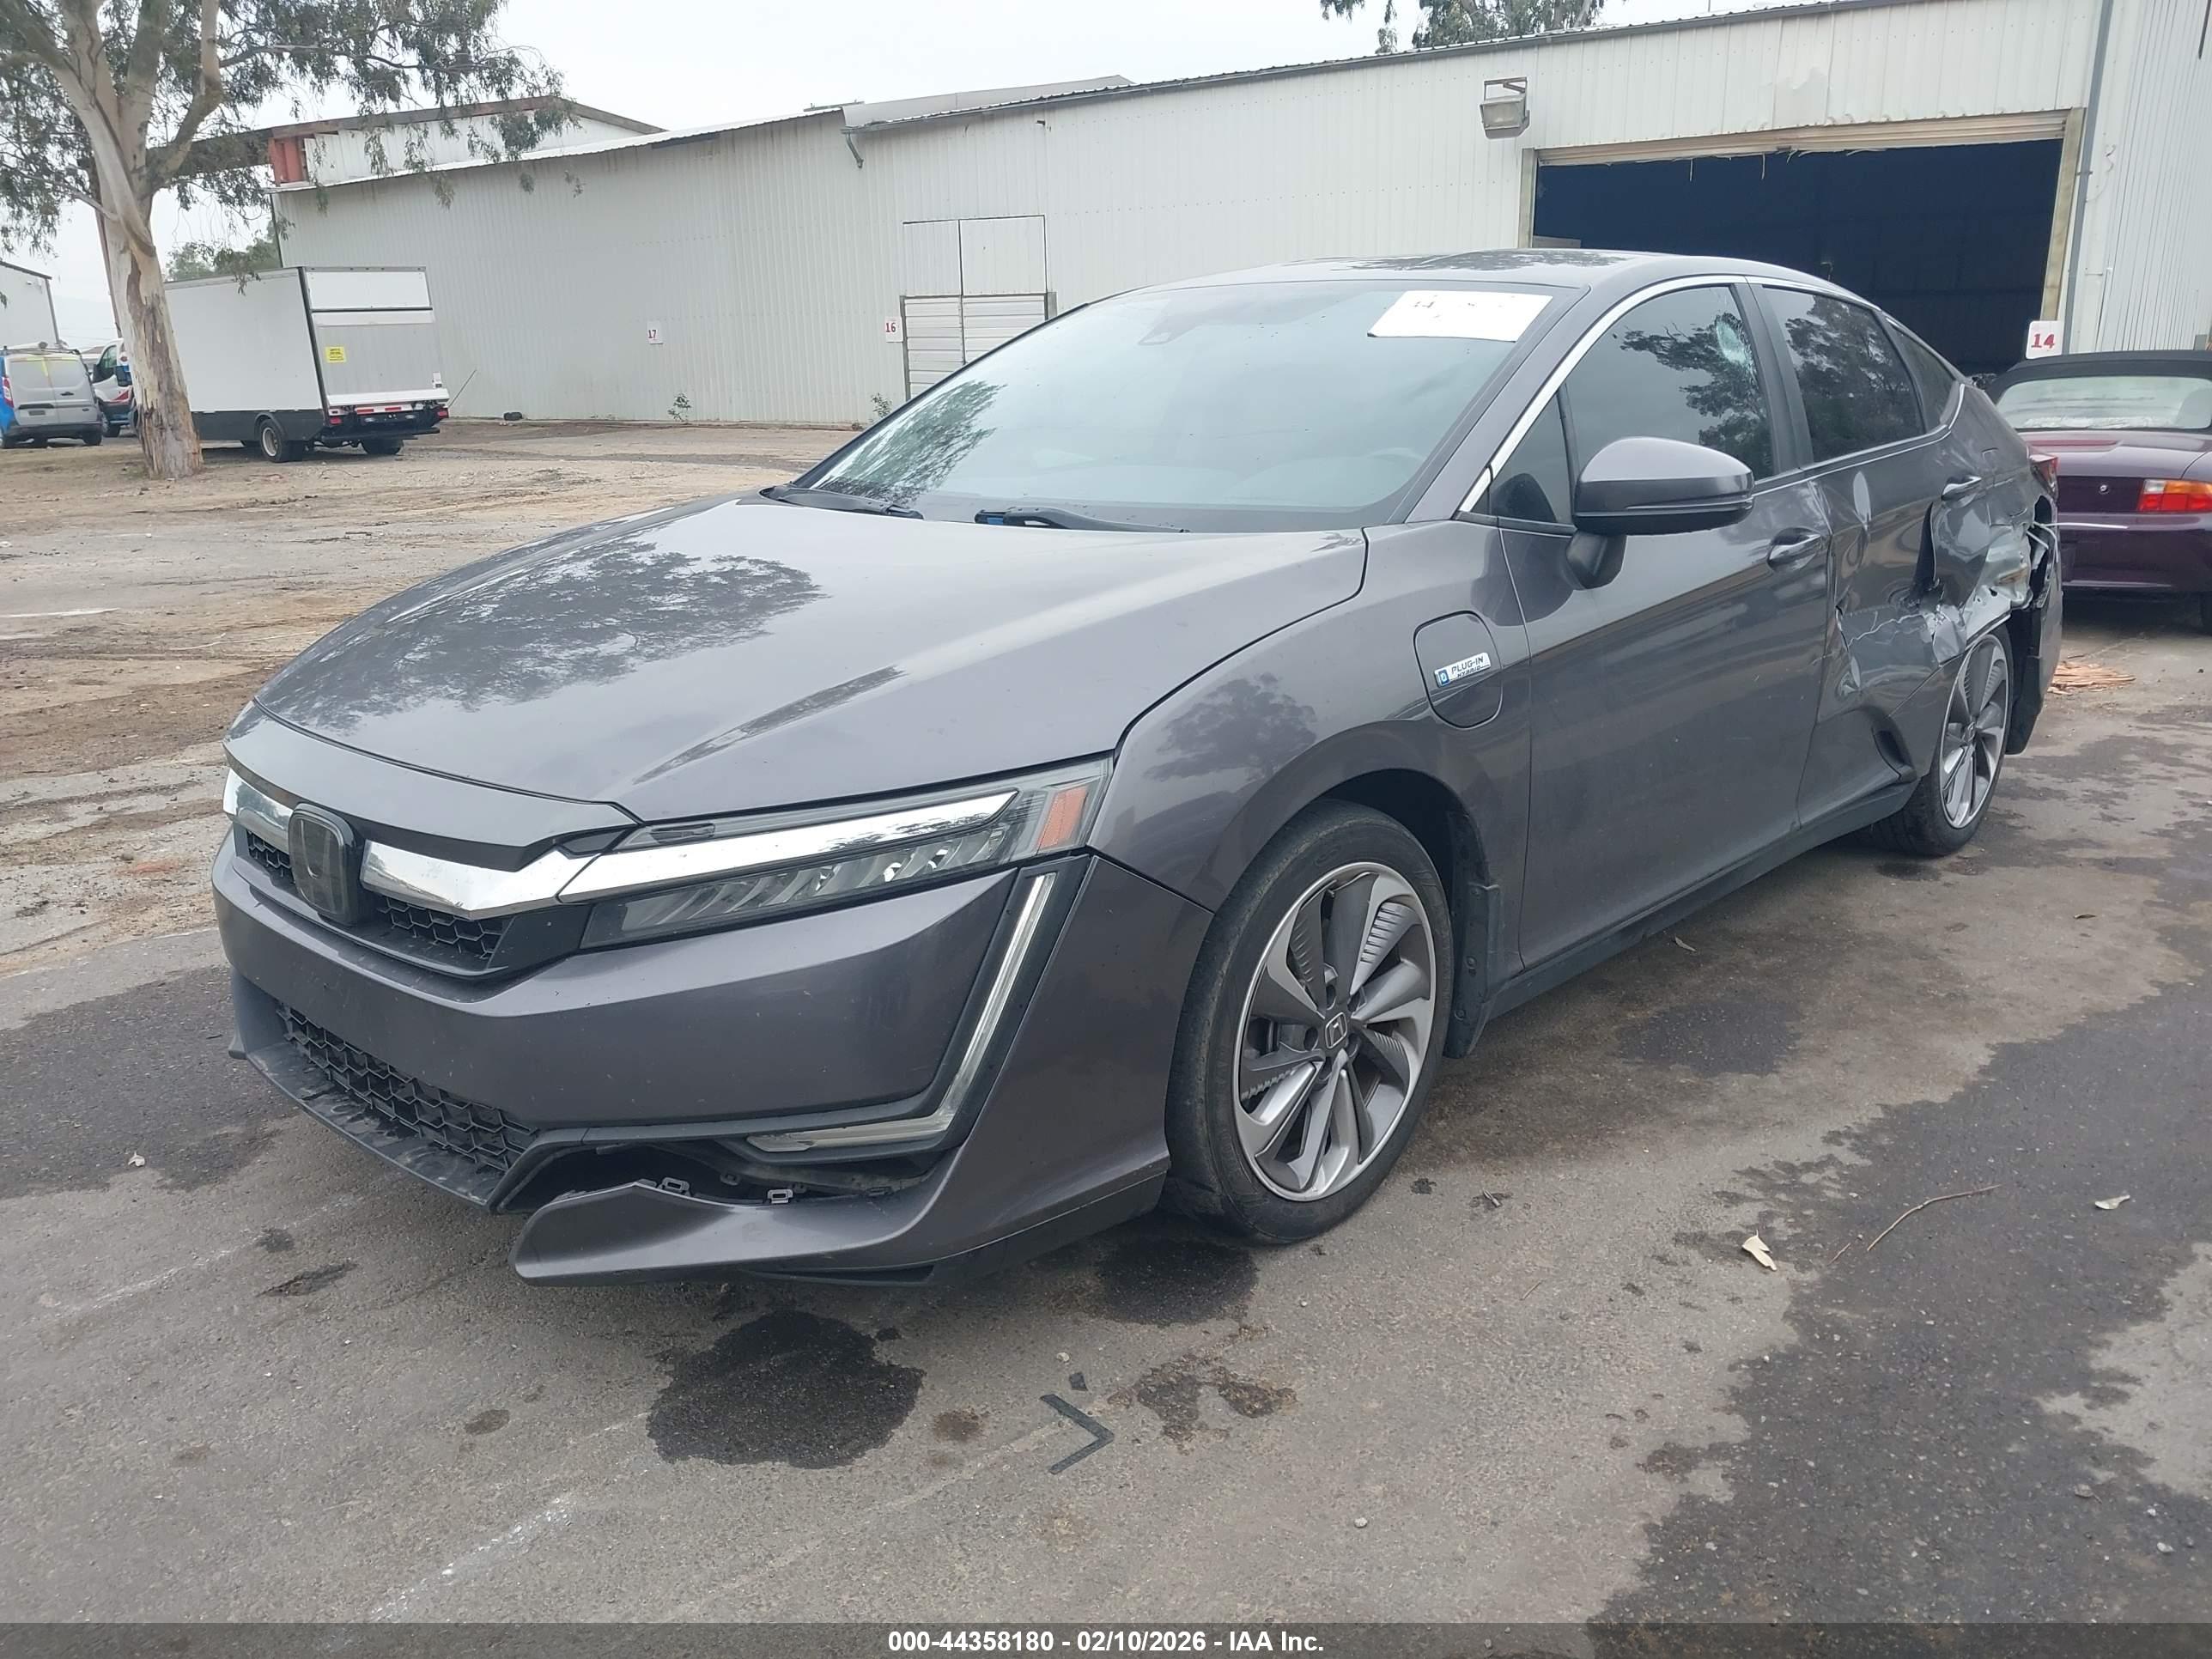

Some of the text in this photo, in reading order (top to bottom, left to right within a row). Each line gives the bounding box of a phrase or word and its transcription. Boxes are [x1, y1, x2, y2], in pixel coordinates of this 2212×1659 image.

[648, 329, 657, 339] 17
[885, 322, 896, 333] 16
[2031, 333, 2055, 349] 14
[1451, 655, 1484, 674] PLUG-IN
